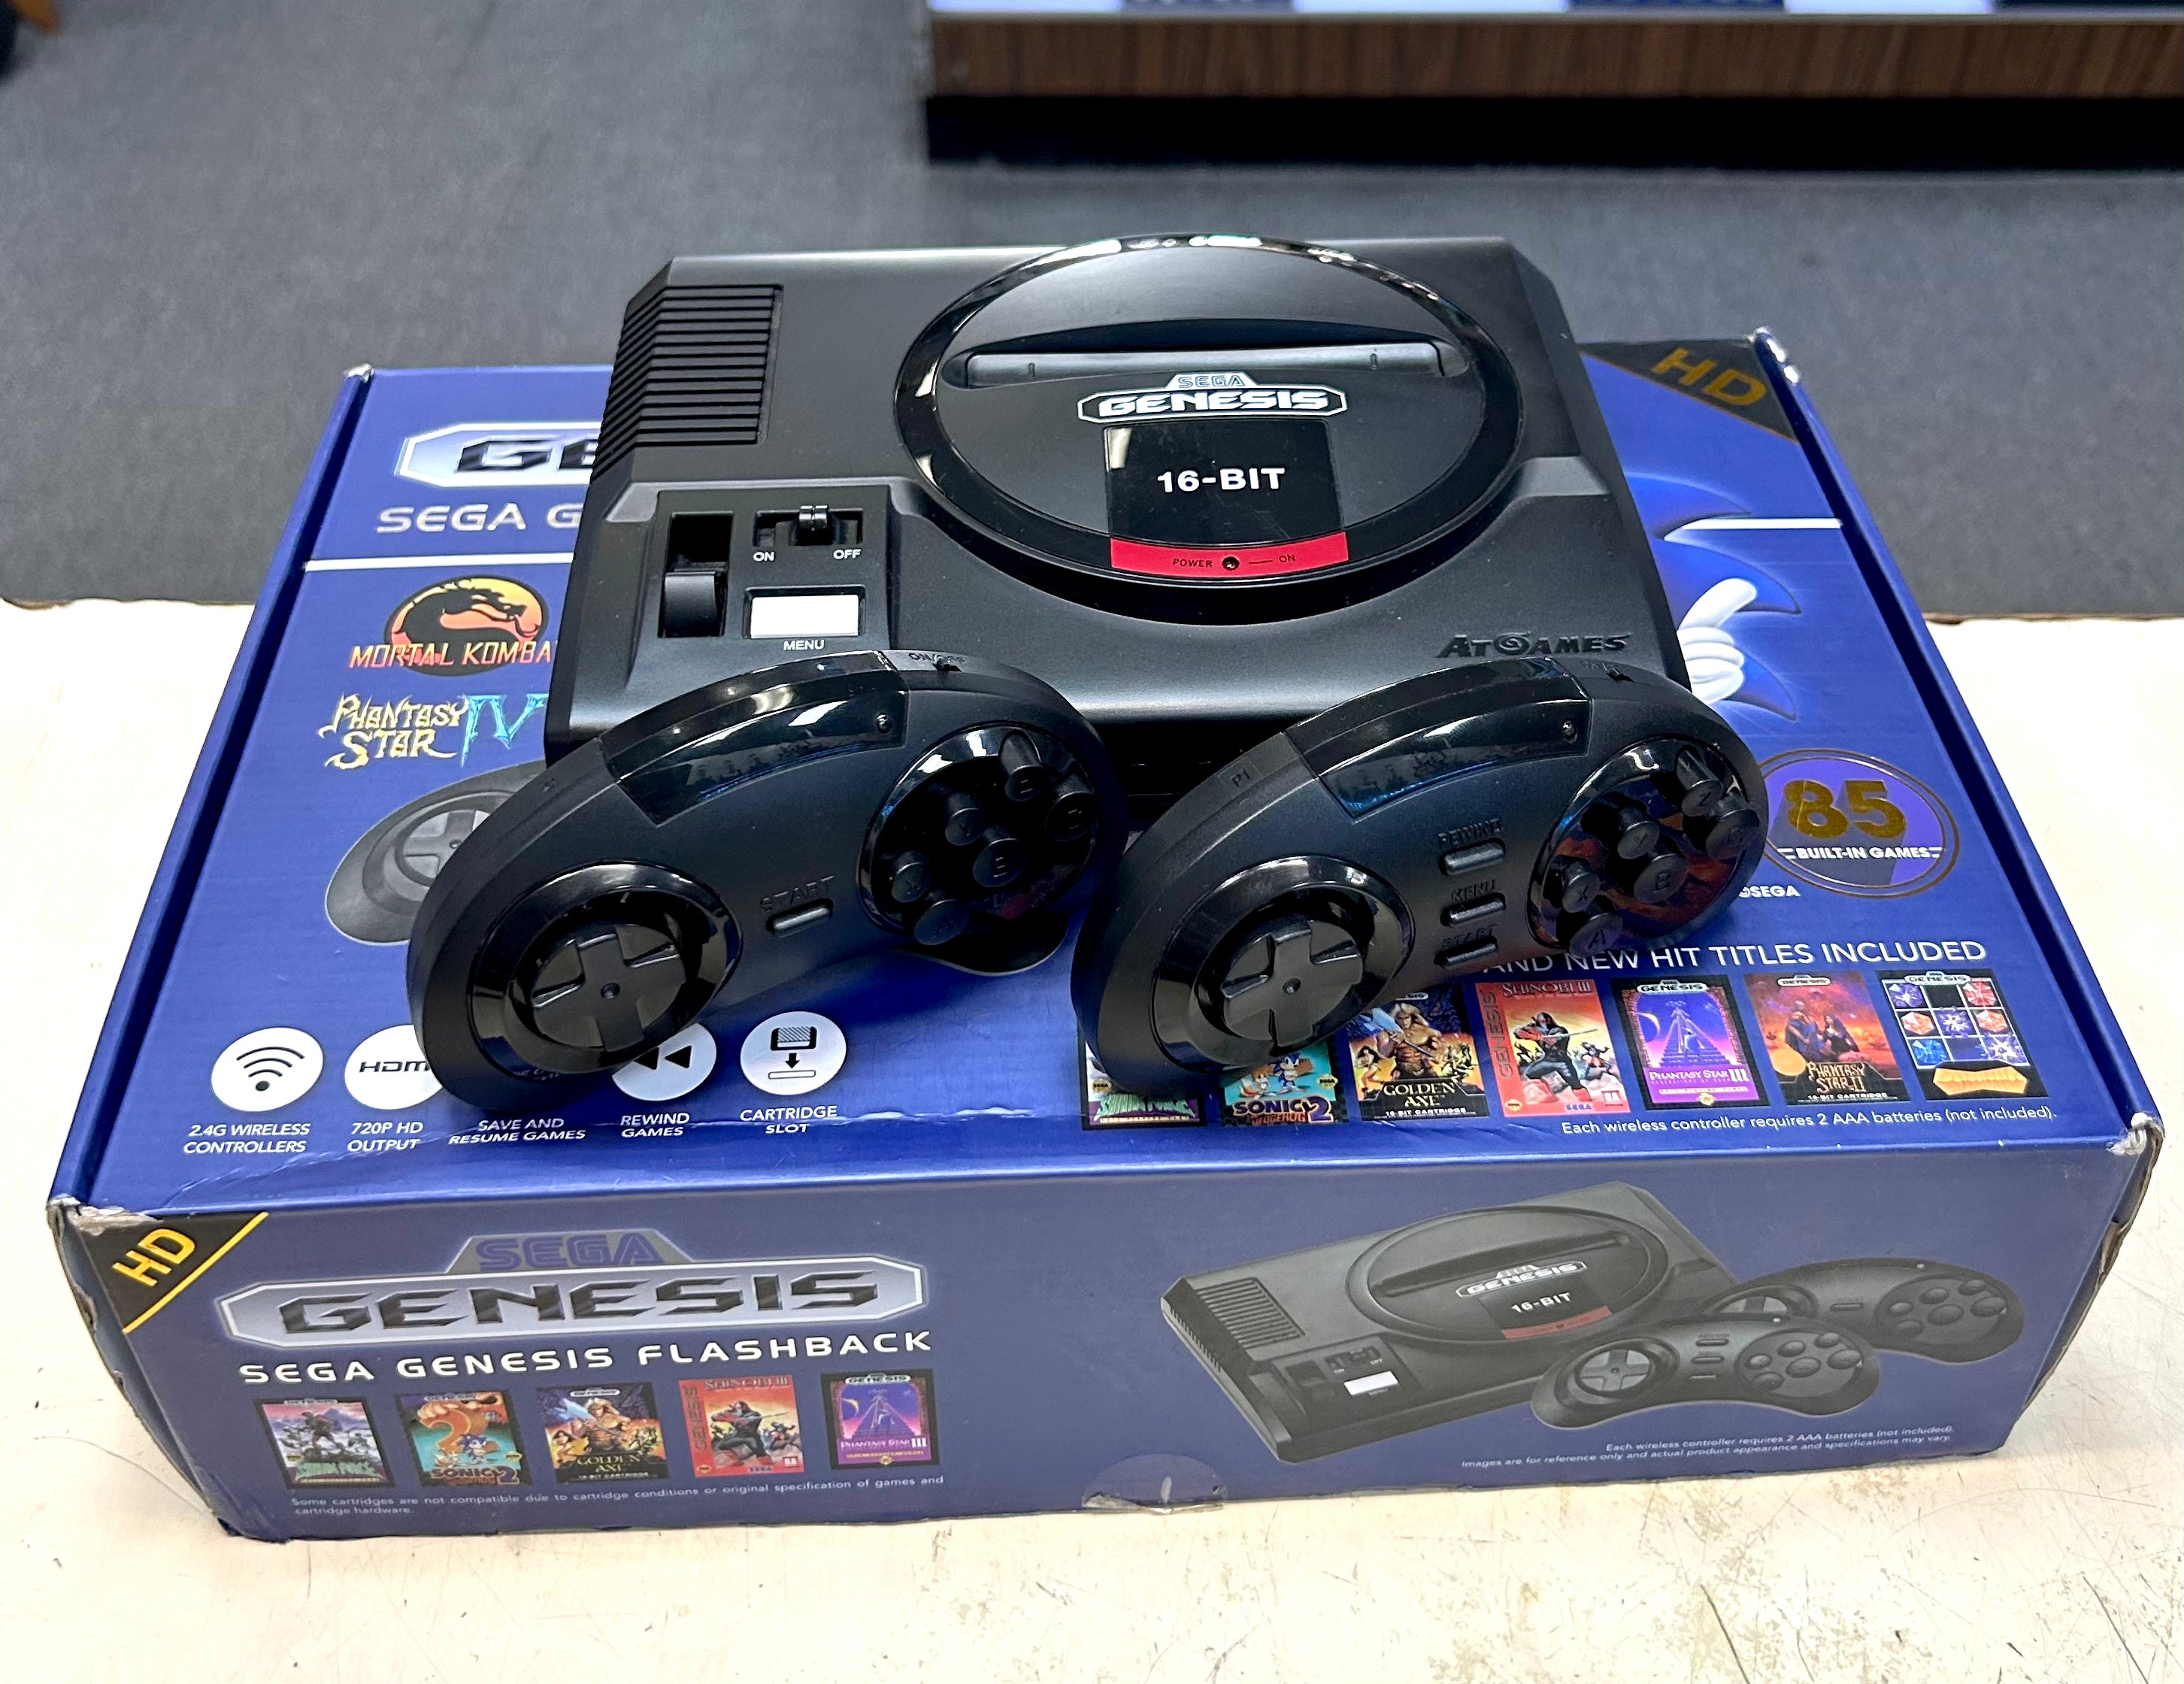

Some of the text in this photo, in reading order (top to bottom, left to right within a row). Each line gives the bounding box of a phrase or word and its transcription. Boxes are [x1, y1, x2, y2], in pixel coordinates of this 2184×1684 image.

[1178, 375, 1246, 387] SEGA
[1652, 347, 1767, 406] HD
[1098, 389, 1330, 416] GENESIS
[1157, 468, 1285, 492] 16-BIT
[377, 501, 526, 534] SEGA
[753, 550, 861, 562] ON OFF
[1172, 553, 1296, 568] POWER ON
[349, 641, 558, 668] MORTAL KOMBA
[783, 640, 825, 650] MENU
[318, 692, 471, 740] PHANTASY
[325, 729, 458, 770] STAR
[1783, 780, 1905, 837] 85
[1796, 847, 1930, 859] BUILT-IN GAMES
[760, 874, 835, 911] START
[1588, 929, 1606, 949] A
[1565, 950, 1637, 971] NEW
[1650, 947, 1700, 968] HIT
[1708, 944, 1813, 965] TITLES
[1820, 941, 1986, 963] INCLUDED
[1502, 980, 1592, 998] SHINOBI III
[1640, 983, 1703, 992] GENESIS
[1481, 992, 1513, 1078] GENESIS
[359, 1060, 431, 1074] HDM
[1648, 1071, 1701, 1080] PHANTASY
[1702, 1069, 1730, 1079] STAR
[1728, 1068, 1749, 1082] III
[1807, 1061, 1865, 1081] PHANTASY
[1383, 1083, 1455, 1095] GOLDEN
[1816, 1076, 1867, 1093] STAR II
[1234, 1095, 1334, 1122] SONIC 2
[1404, 1095, 1440, 1107] AXE
[620, 1113, 690, 1126] REWIND
[740, 1106, 838, 1122] CARTRIDGE
[1562, 1106, 2057, 1134] Each wireless controller requires 2 AAA batteries (not included).
[189, 1122, 310, 1137] 2.4G WIRELESS
[350, 1121, 423, 1135] 720P HD
[477, 1118, 565, 1131] SAVE AND
[621, 1126, 683, 1138] GAMES
[765, 1123, 809, 1134] SLOT
[183, 1140, 306, 1154] CONTROLLERS
[347, 1138, 421, 1152] OUTPUT
[448, 1129, 586, 1145] RESUME GAMES
[112, 1228, 197, 1286] HD
[475, 1231, 664, 1271] SEGA
[1467, 1263, 1577, 1295] GENESIS
[279, 1271, 879, 1334] GENESIS
[1511, 1292, 1571, 1313] 16-BIT
[239, 1330, 931, 1383] SEGA GENESIS FLASHBACK
[911, 1437, 927, 1448] III
[1606, 1443, 1632, 1452] Each
[1636, 1440, 1679, 1449] wireless
[1683, 1437, 1737, 1448] controller
[1739, 1436, 1783, 1446] requires
[1797, 1433, 1822, 1441] AAA
[1825, 1431, 1873, 1440] batteries
[1877, 1428, 1898, 1438] (not
[1462, 1460, 1501, 1468] Images
[1544, 1454, 1596, 1463] reference
[1600, 1452, 1622, 1461] only
[1626, 1450, 1647, 1458] and
[1651, 1448, 1683, 1458] actual
[1687, 1446, 1730, 1457] product
[1733, 1444, 1798, 1455] appearance
[1801, 1442, 1822, 1450] and
[1825, 1438, 1898, 1449] specifications
[1902, 1437, 1924, 1445] may
[1928, 1434, 1950, 1443] vary.
[431, 1467, 495, 1479] SONIC
[494, 1465, 519, 1485] 2
[291, 1497, 326, 1505] Some
[332, 1497, 394, 1507] cartridges
[424, 1496, 445, 1504] not
[450, 1495, 519, 1506] compatible
[525, 1492, 550, 1501] due
[573, 1491, 629, 1501] cartridge
[635, 1487, 698, 1498] conditions
[722, 1484, 768, 1495] original
[774, 1480, 851, 1493] specification
[857, 1479, 870, 1487] of
[875, 1478, 916, 1489] games
[921, 1475, 944, 1485] and
[295, 1505, 415, 1517] cartridge hardware.
